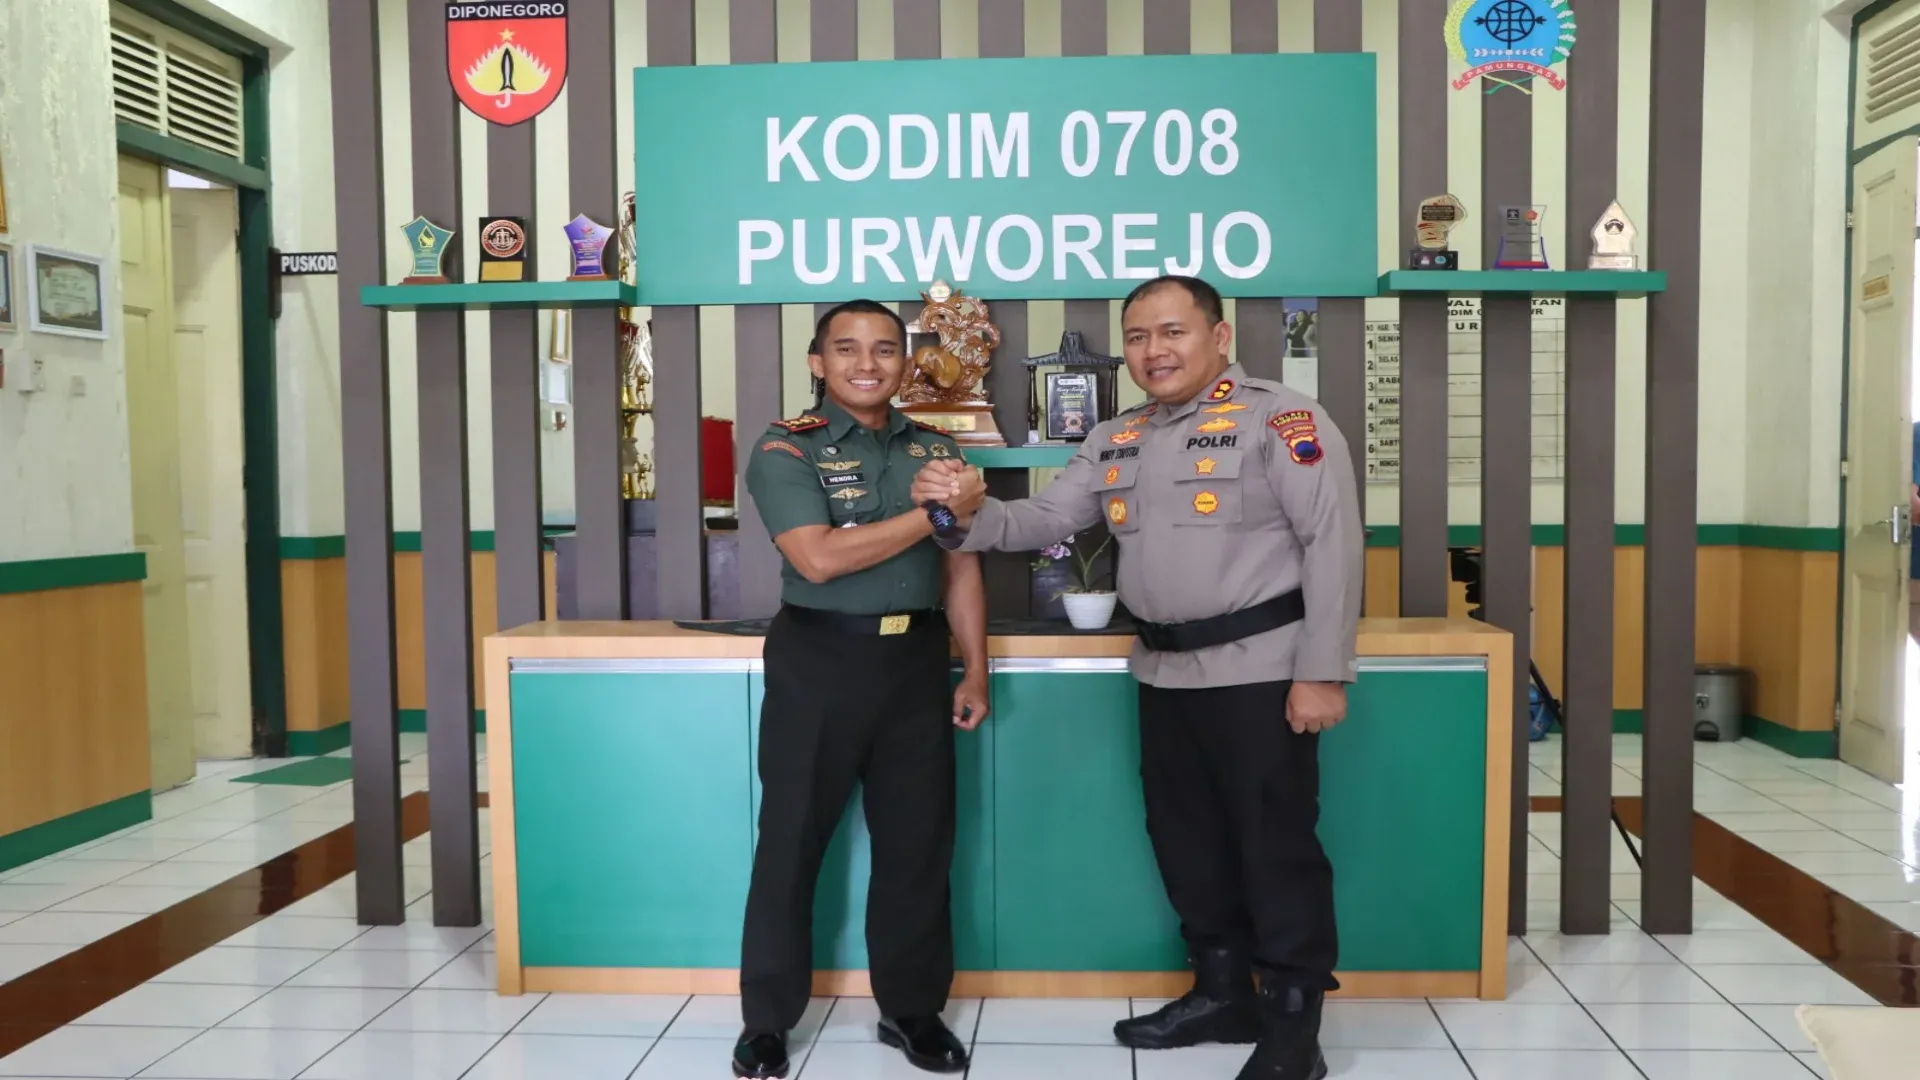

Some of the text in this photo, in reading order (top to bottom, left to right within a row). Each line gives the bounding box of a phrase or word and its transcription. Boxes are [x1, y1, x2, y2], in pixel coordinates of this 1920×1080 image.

[448, 3, 565, 18] DIPONEGORO
[1466, 62, 1552, 79] PAMUNGKAS
[766, 108, 1240, 183] KODIM 0708
[738, 211, 1273, 286] PURWOREJO
[1367, 340, 1373, 350] 1
[1367, 361, 1374, 370] 2
[1367, 382, 1374, 391] 3
[1367, 403, 1374, 412] 4
[1368, 423, 1375, 432] 5
[1186, 434, 1238, 450] POLRI
[1368, 444, 1375, 453] 6
[1368, 464, 1375, 474] 7
[828, 474, 858, 484] HENDRA
